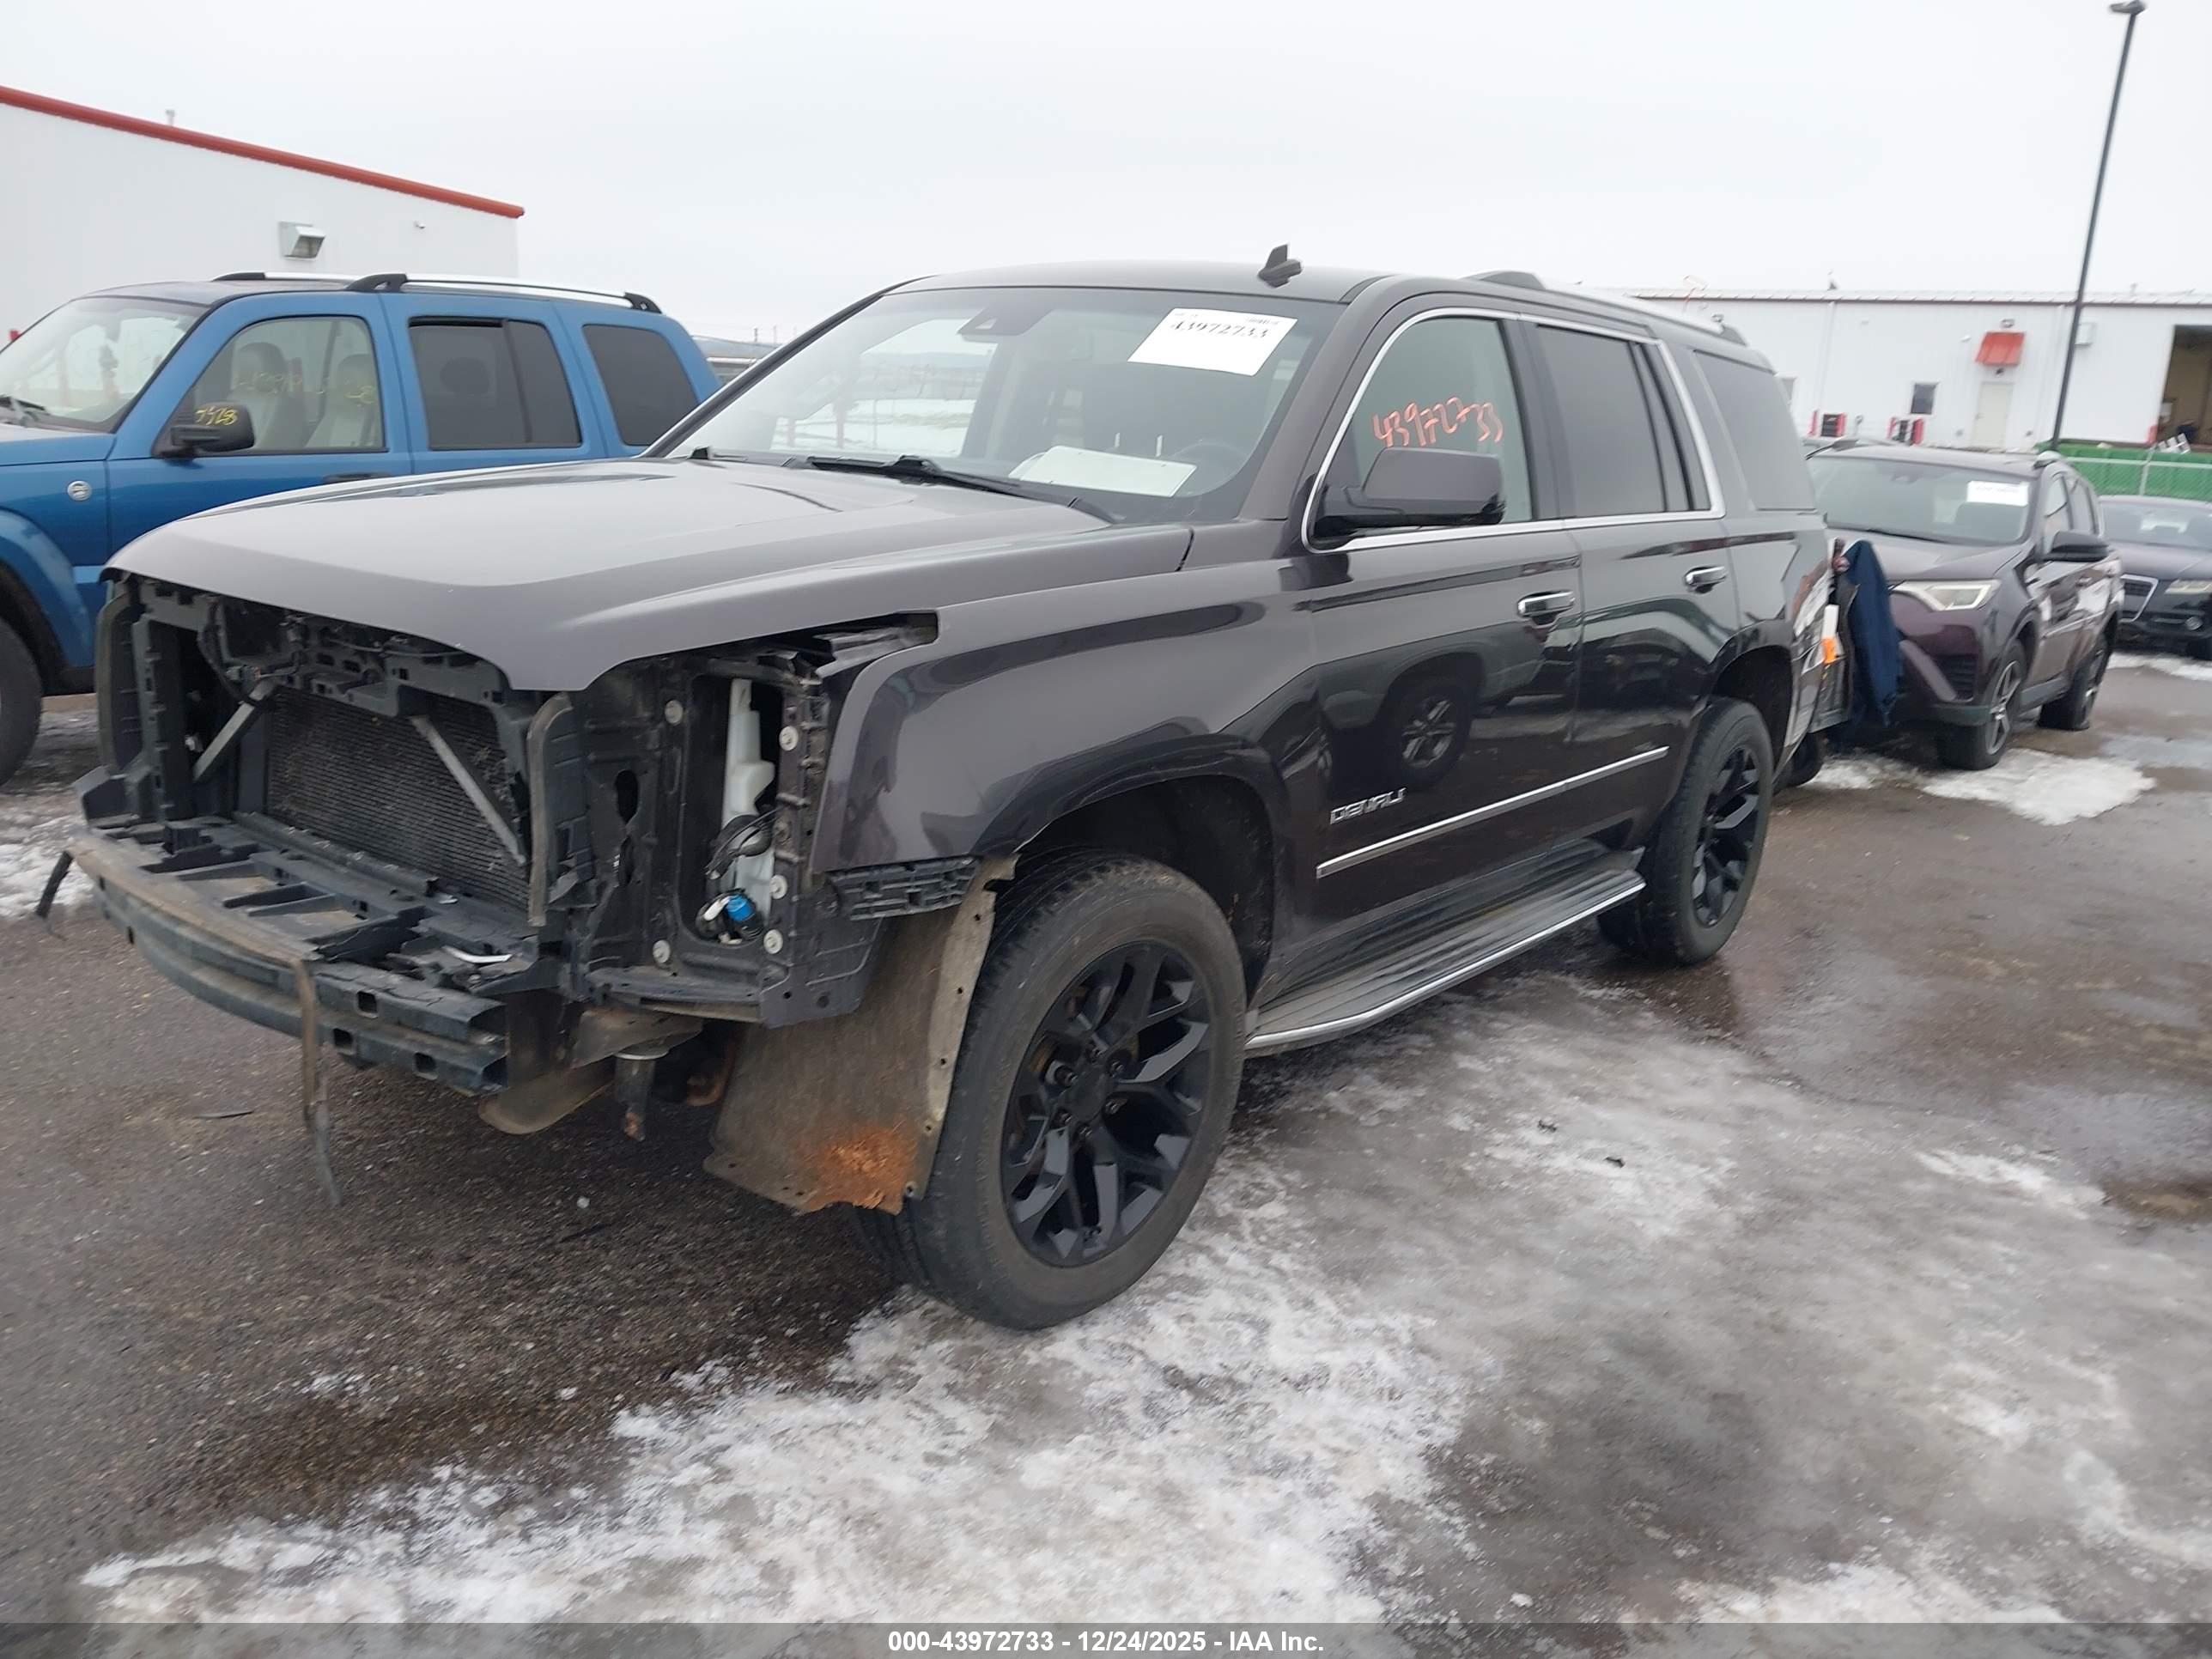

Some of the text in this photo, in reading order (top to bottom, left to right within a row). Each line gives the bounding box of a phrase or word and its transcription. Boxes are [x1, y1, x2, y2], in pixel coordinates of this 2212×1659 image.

[1171, 320, 1269, 338] 43972733
[1372, 396, 1504, 447] 43972733
[1329, 787, 1407, 825] DENALI
